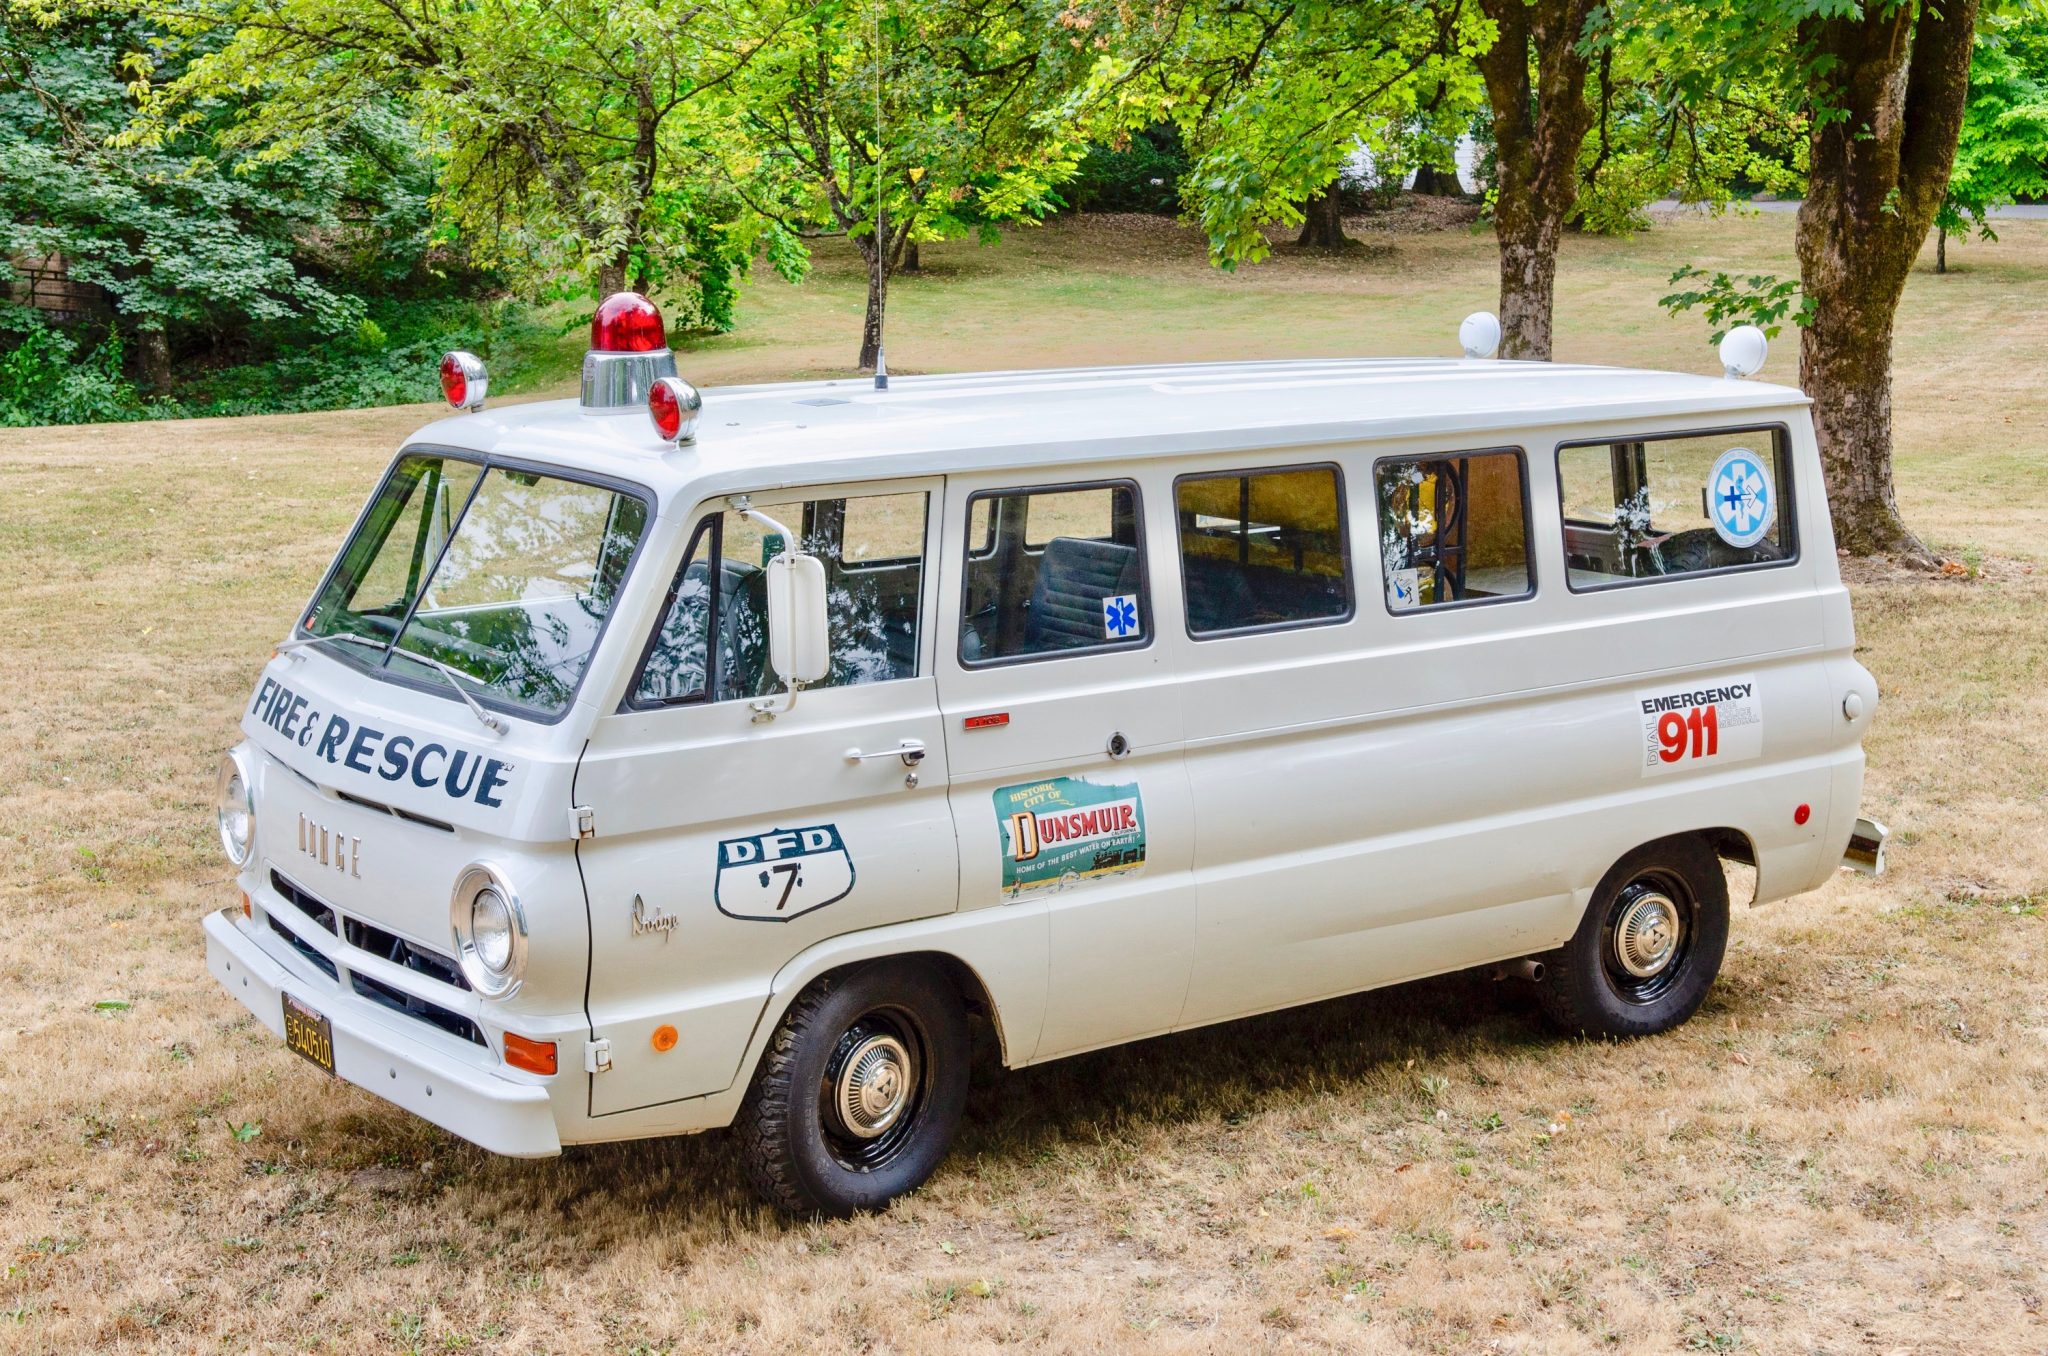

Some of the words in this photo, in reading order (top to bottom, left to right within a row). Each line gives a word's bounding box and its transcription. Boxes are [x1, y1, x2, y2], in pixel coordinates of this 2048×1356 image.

[1641, 683, 1752, 714] EMERGENCY
[252, 677, 309, 741] FIRE
[316, 713, 514, 809] RESCUE
[1646, 716, 1659, 767] DIAL
[1657, 705, 1718, 763] 911
[1010, 783, 1055, 803] HISTORIC
[1024, 793, 1045, 808] CITY
[1048, 790, 1061, 800] OF
[725, 828, 832, 864] DFD
[1010, 804, 1137, 863] DUNSMUIR
[1016, 864, 1036, 874] HOME
[1037, 861, 1046, 870] OF
[1048, 857, 1060, 867] THE
[1061, 851, 1078, 862] BEST
[1079, 841, 1100, 855] WATER
[1101, 839, 1111, 849] ON
[771, 862, 798, 911] 7
[631, 890, 682, 943] Dodge
[293, 1018, 332, 1069] 540510
